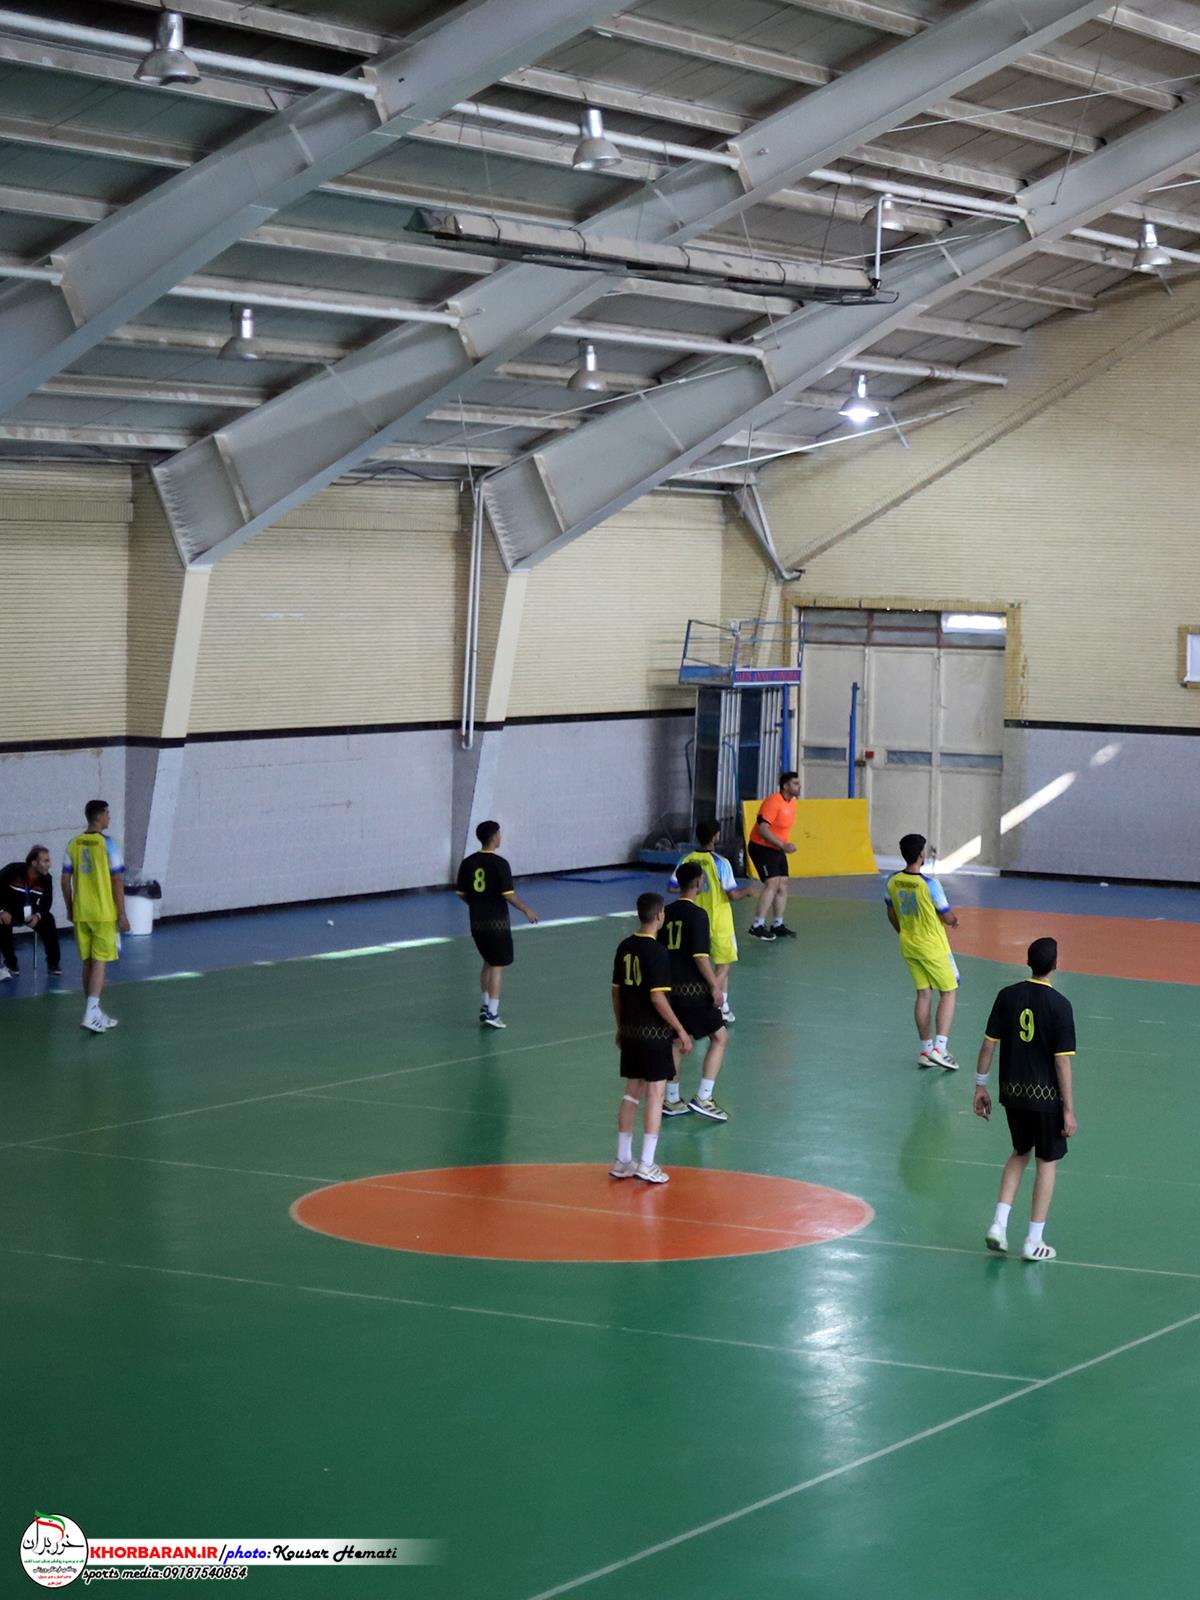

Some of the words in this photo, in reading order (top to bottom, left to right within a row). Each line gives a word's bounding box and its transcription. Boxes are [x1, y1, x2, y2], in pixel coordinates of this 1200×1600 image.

[473, 867, 486, 893] 8
[666, 920, 683, 950] 17
[623, 953, 642, 987] 10
[1019, 1008, 1035, 1043] 9
